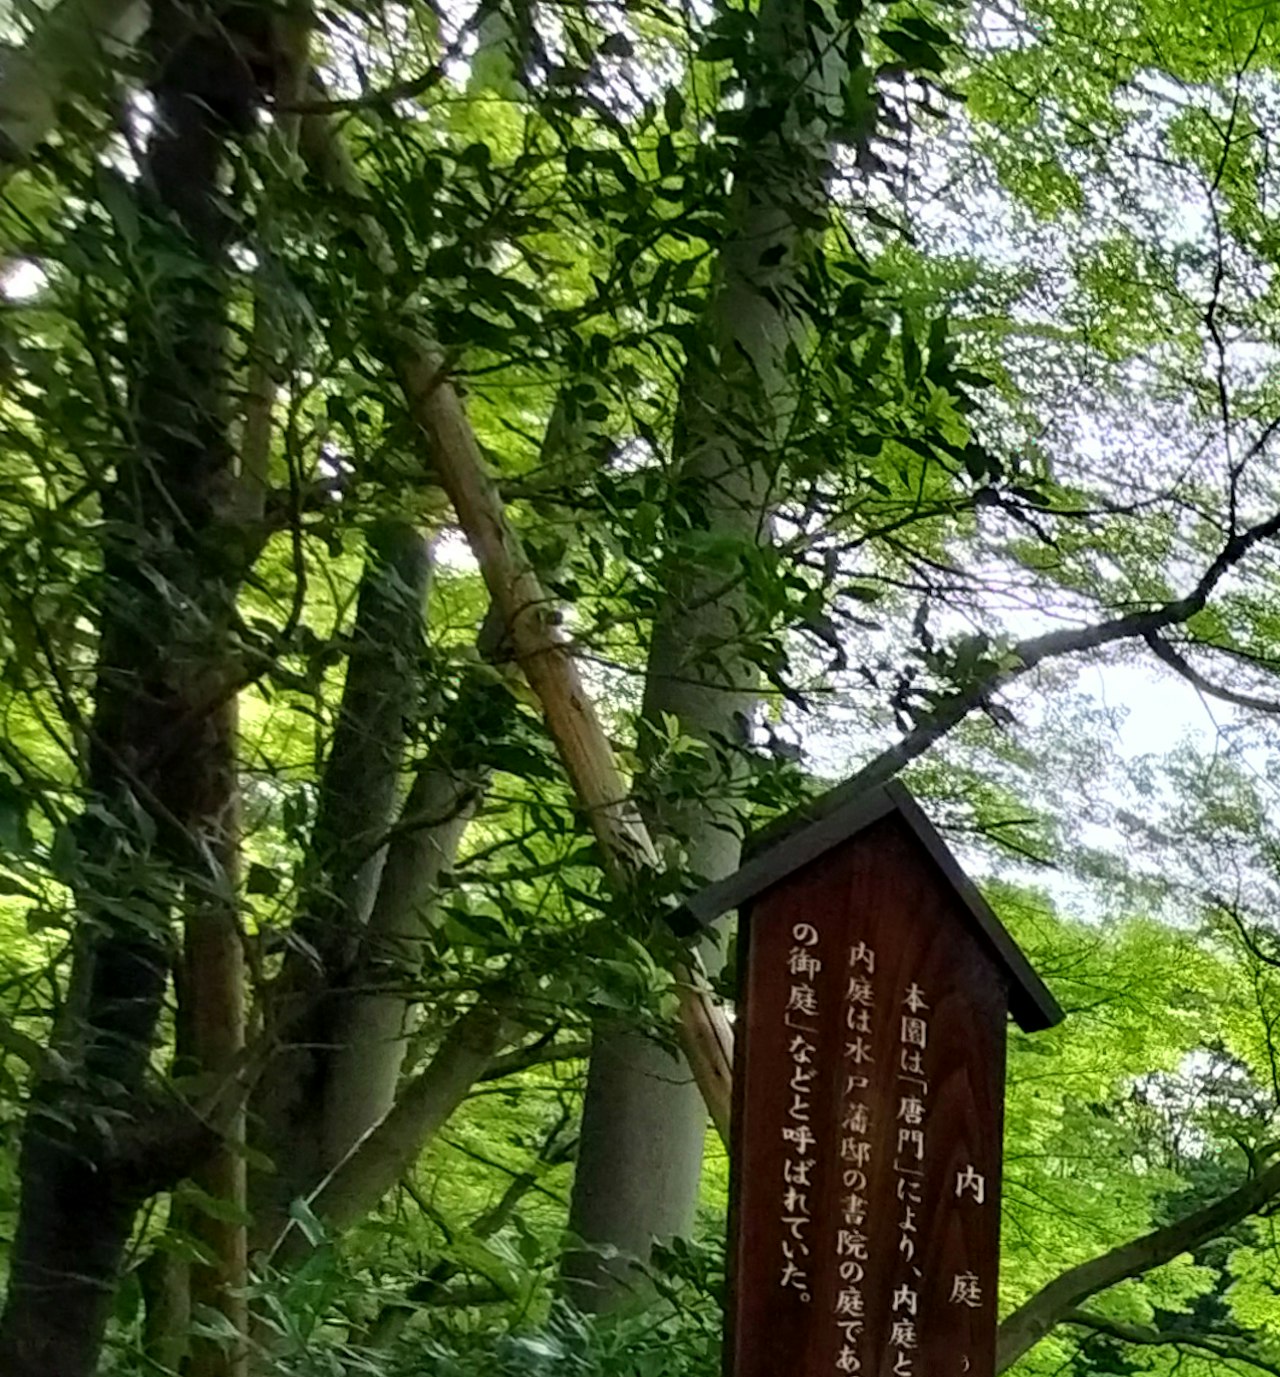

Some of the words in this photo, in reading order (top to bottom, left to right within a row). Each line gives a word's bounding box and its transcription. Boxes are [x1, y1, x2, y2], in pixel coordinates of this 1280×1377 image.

[780, 922, 822, 1303] の御庭」などと呼ばれていた。
